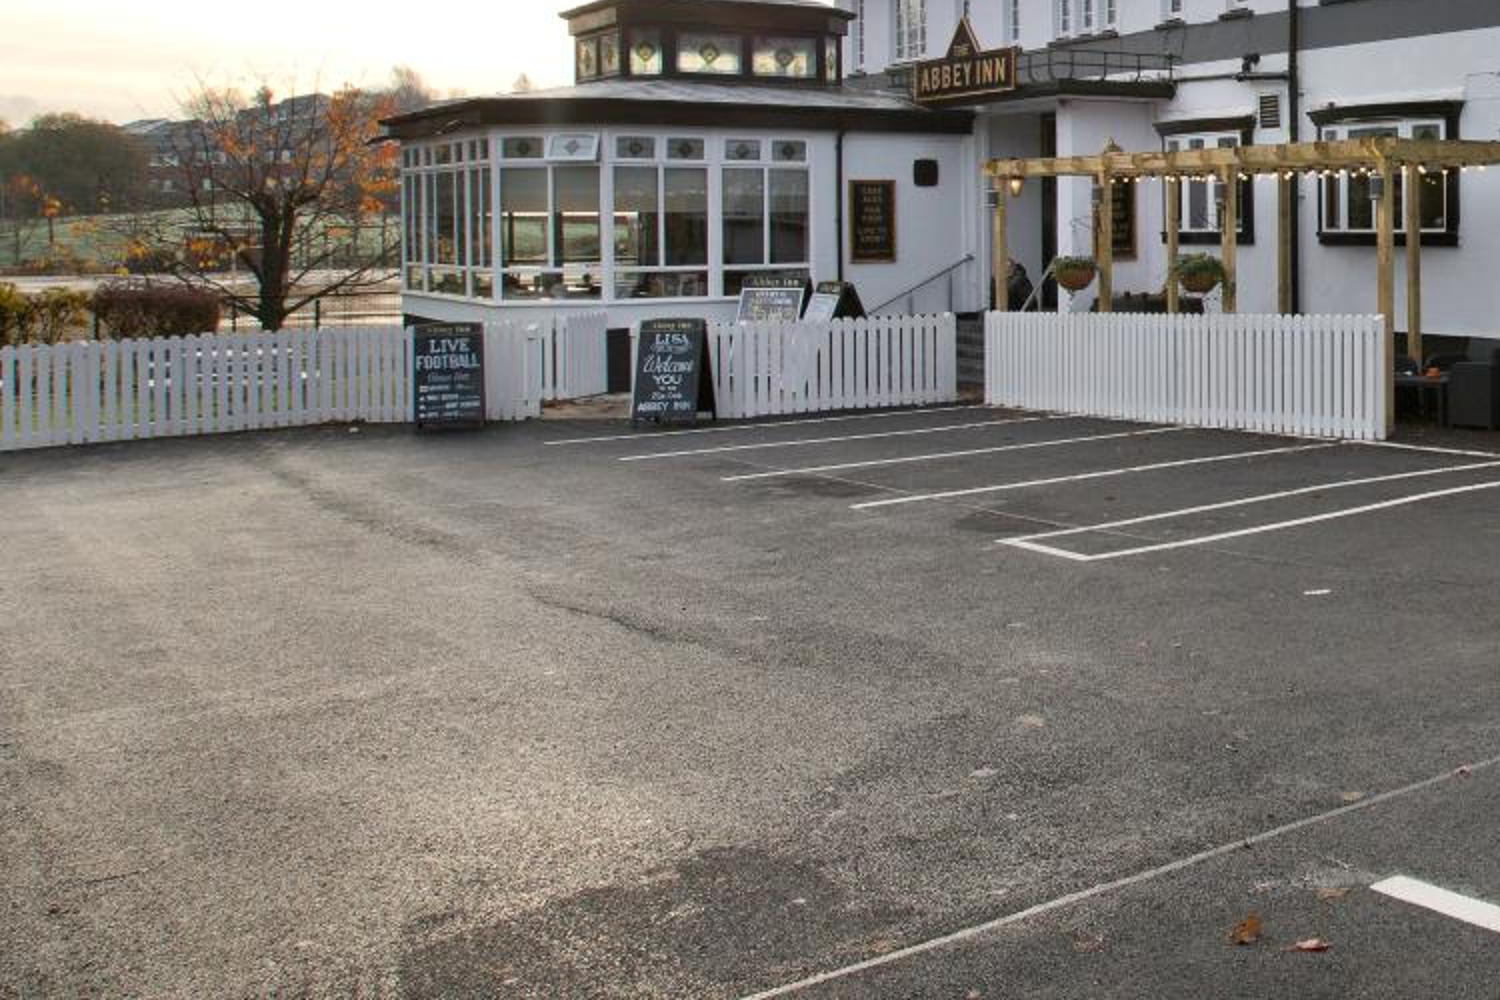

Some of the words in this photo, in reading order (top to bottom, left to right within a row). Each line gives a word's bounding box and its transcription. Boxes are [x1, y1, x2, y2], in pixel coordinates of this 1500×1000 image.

[920, 62, 973, 94] ABBEY
[974, 57, 1006, 87] INN
[428, 338, 471, 353] LIVE
[415, 352, 481, 370] FOOTBALL
[652, 374, 683, 385] YOU
